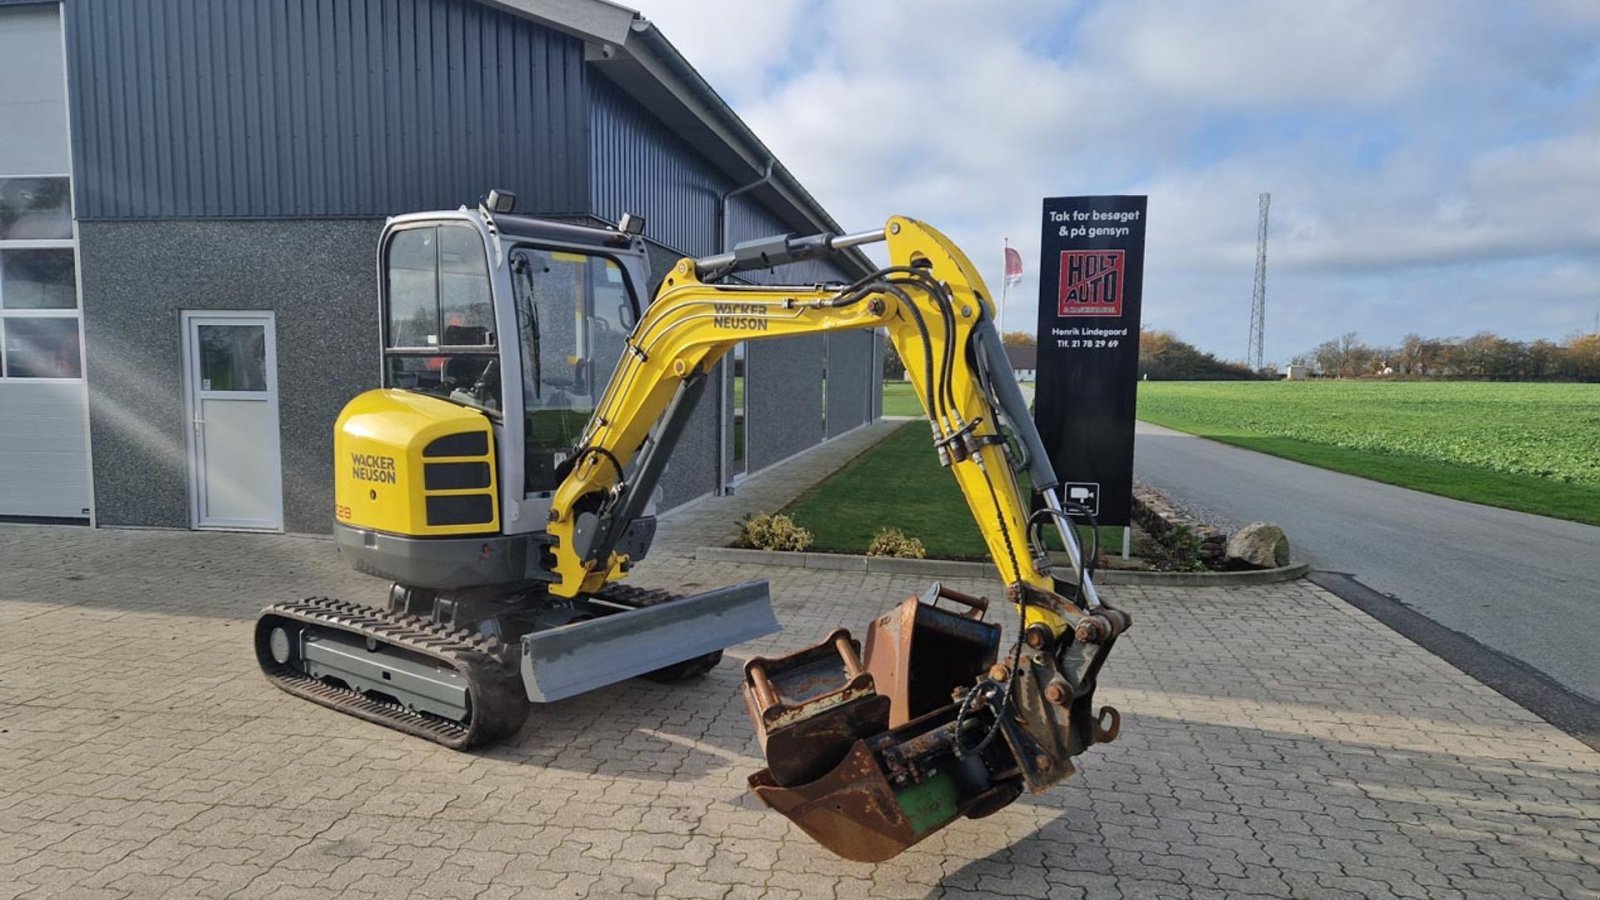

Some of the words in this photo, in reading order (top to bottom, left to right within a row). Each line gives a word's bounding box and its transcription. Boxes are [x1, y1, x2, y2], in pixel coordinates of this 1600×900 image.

[1049, 211, 1070, 222] Tak
[1073, 210, 1090, 221] for
[1093, 210, 1140, 223] besøget
[1058, 226, 1069, 236] &
[1071, 225, 1086, 238] på
[1088, 227, 1129, 238] gensyn
[1068, 254, 1118, 287] HOLT
[1064, 269, 1117, 303] AUTO
[713, 314, 768, 331] NEUSON
[1051, 327, 1080, 335] Henrik
[1082, 327, 1128, 337] Lindegaard
[1071, 340, 1080, 348] 21
[1082, 340, 1093, 348] 78
[1095, 340, 1106, 348] 29
[1108, 340, 1119, 348] 69
[351, 453, 395, 470] WACKER
[352, 467, 396, 484] NEUSON
